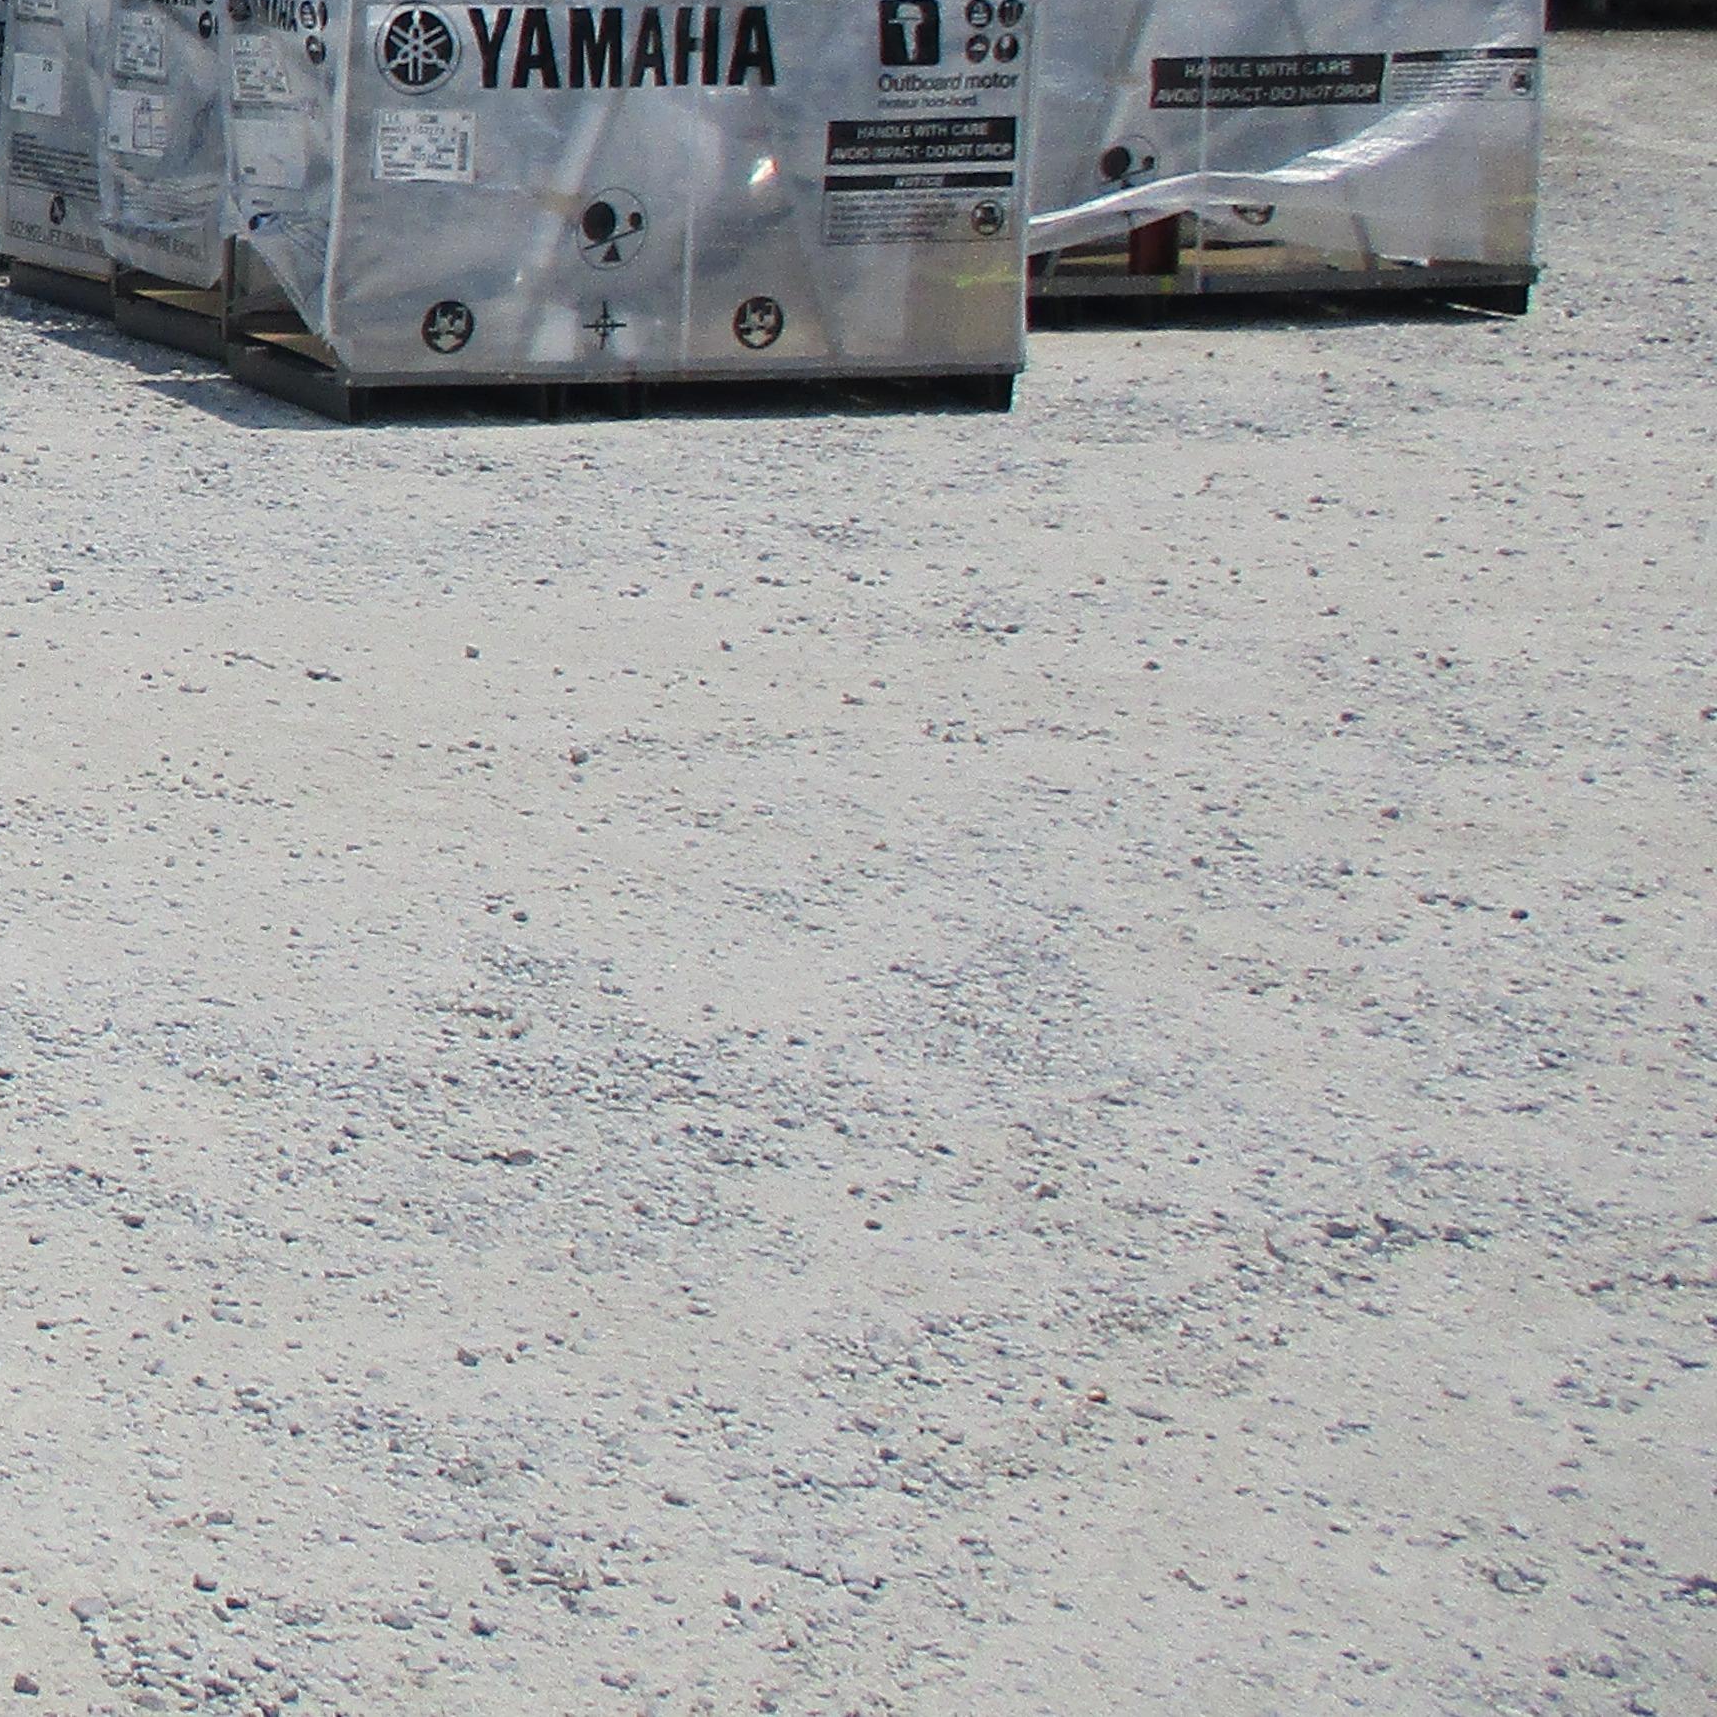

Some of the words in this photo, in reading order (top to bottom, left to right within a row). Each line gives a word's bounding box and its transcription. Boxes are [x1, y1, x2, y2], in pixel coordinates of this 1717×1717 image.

[467, 6, 777, 89] YAMAHA
[878, 73, 961, 93] Outboard
[966, 72, 1019, 89] motor
[856, 125, 912, 140] HANDLE
[915, 124, 948, 138] WITH
[951, 122, 989, 137] CARE
[831, 146, 870, 161] AVOID
[948, 144, 973, 158] NOT
[975, 142, 1013, 157] DROP
